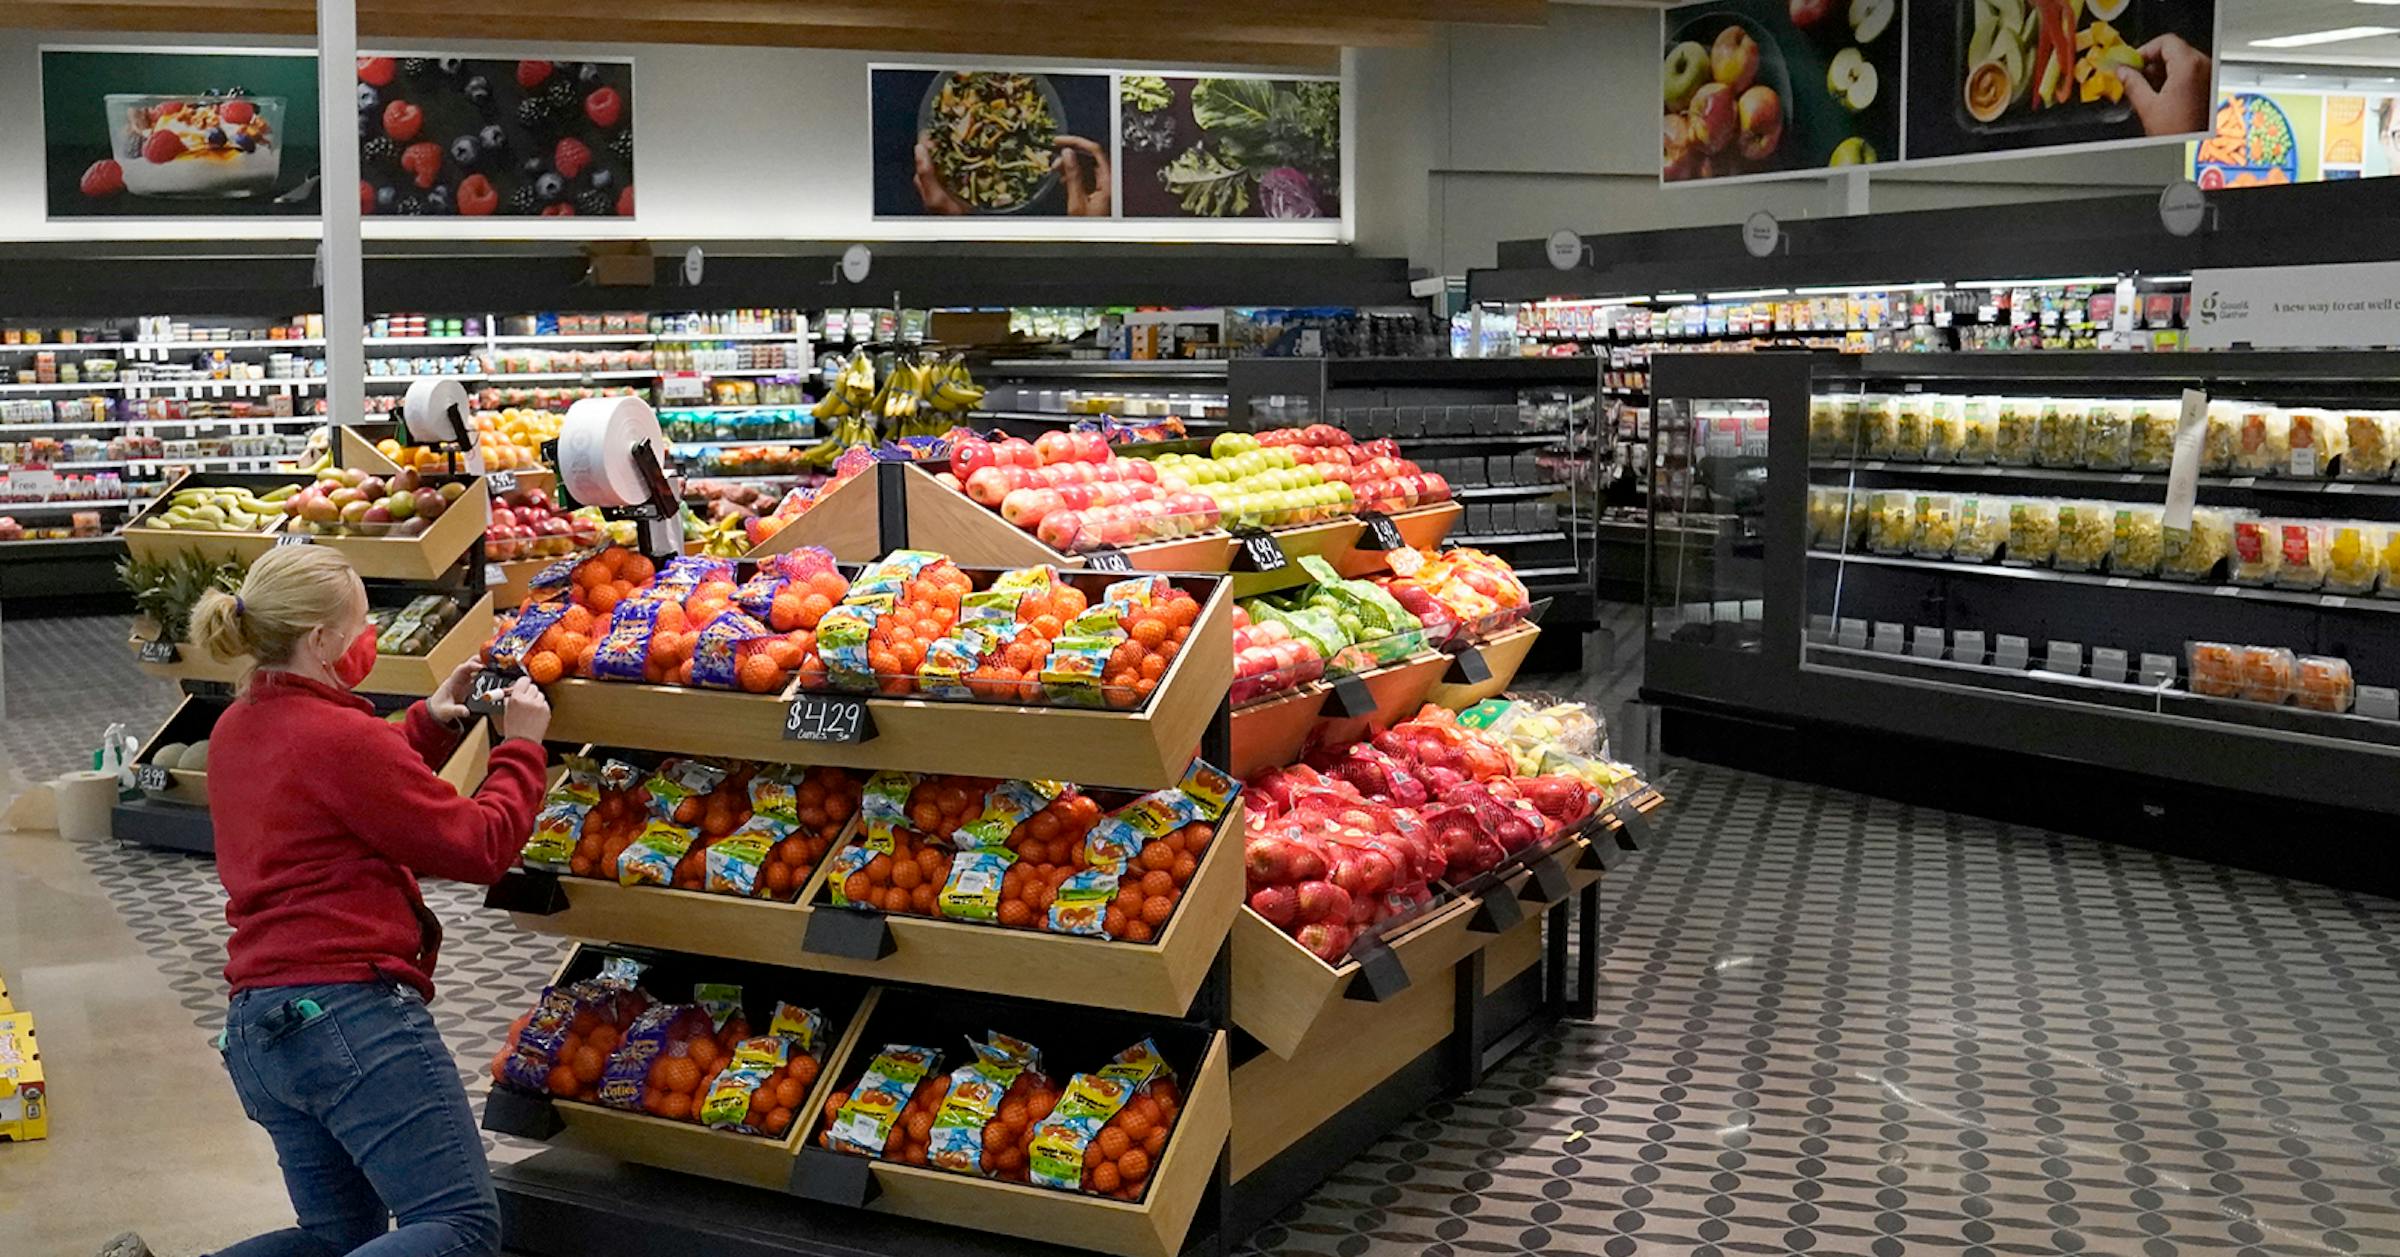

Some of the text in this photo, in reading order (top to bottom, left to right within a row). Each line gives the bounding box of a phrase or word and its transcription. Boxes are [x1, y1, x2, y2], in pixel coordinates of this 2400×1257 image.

[2282, 303, 2305, 312] new
[2308, 303, 2329, 314] way
[2332, 301, 2345, 311] to
[2347, 301, 2365, 311] eat
[2368, 298, 2392, 311] well
[787, 700, 860, 733] $4.29
